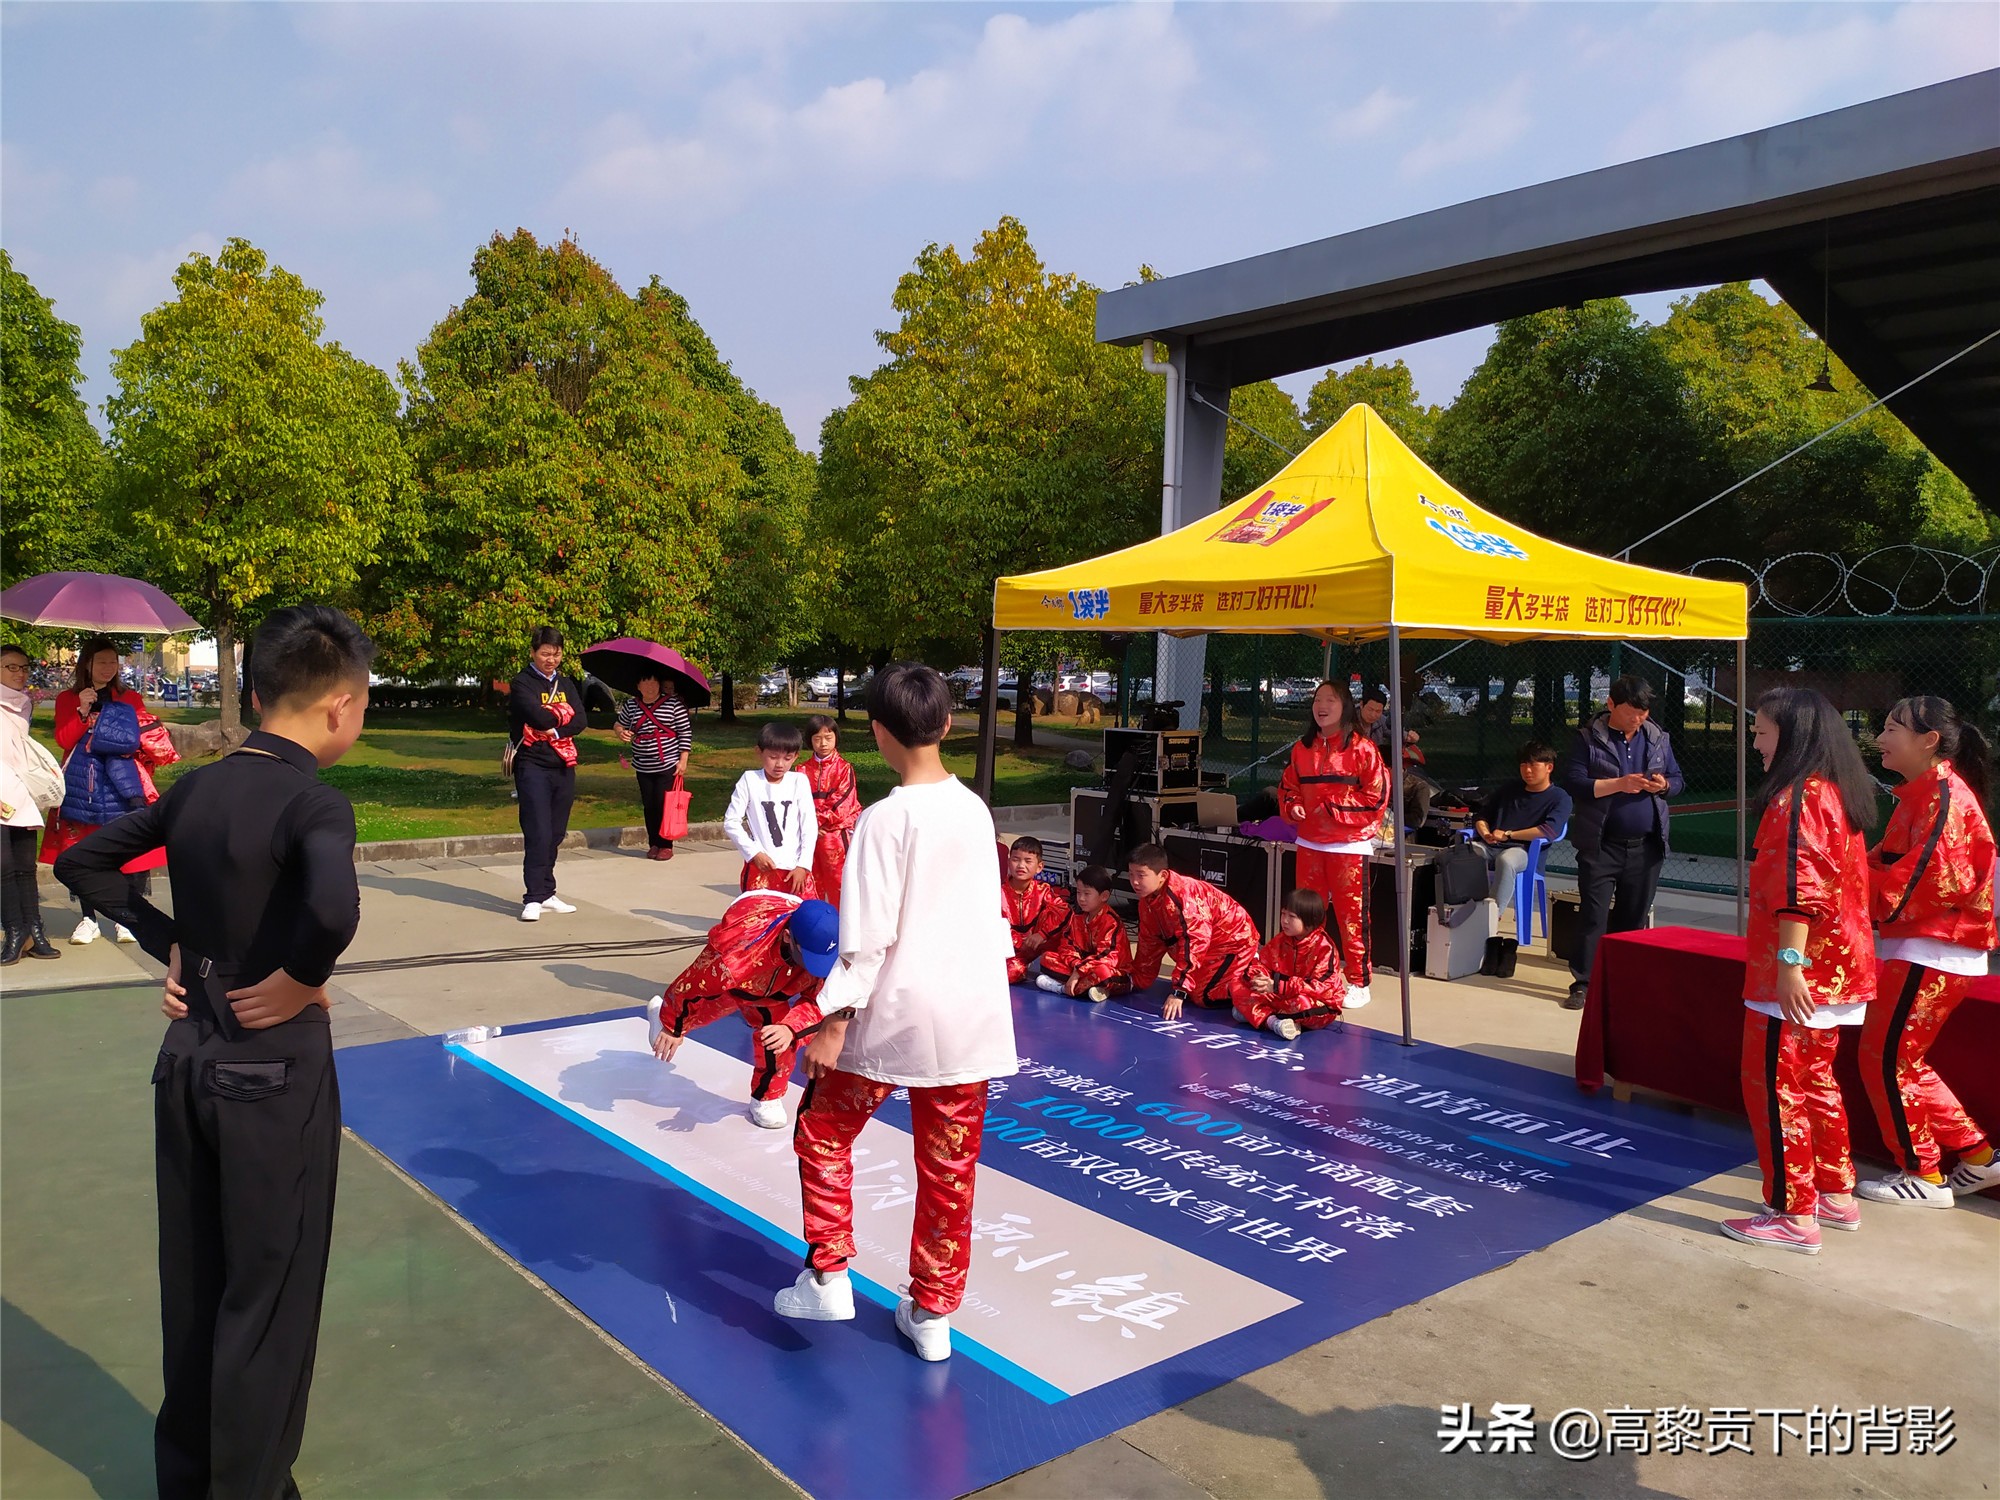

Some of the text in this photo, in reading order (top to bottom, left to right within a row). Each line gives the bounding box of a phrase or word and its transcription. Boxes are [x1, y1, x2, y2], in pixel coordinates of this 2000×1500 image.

[1138, 590, 1205, 615] 量大多半袋
[1484, 585, 1570, 622] 量大多半袋
[761, 800, 793, 848] V
[1340, 1073, 1638, 1159] 温情面世
